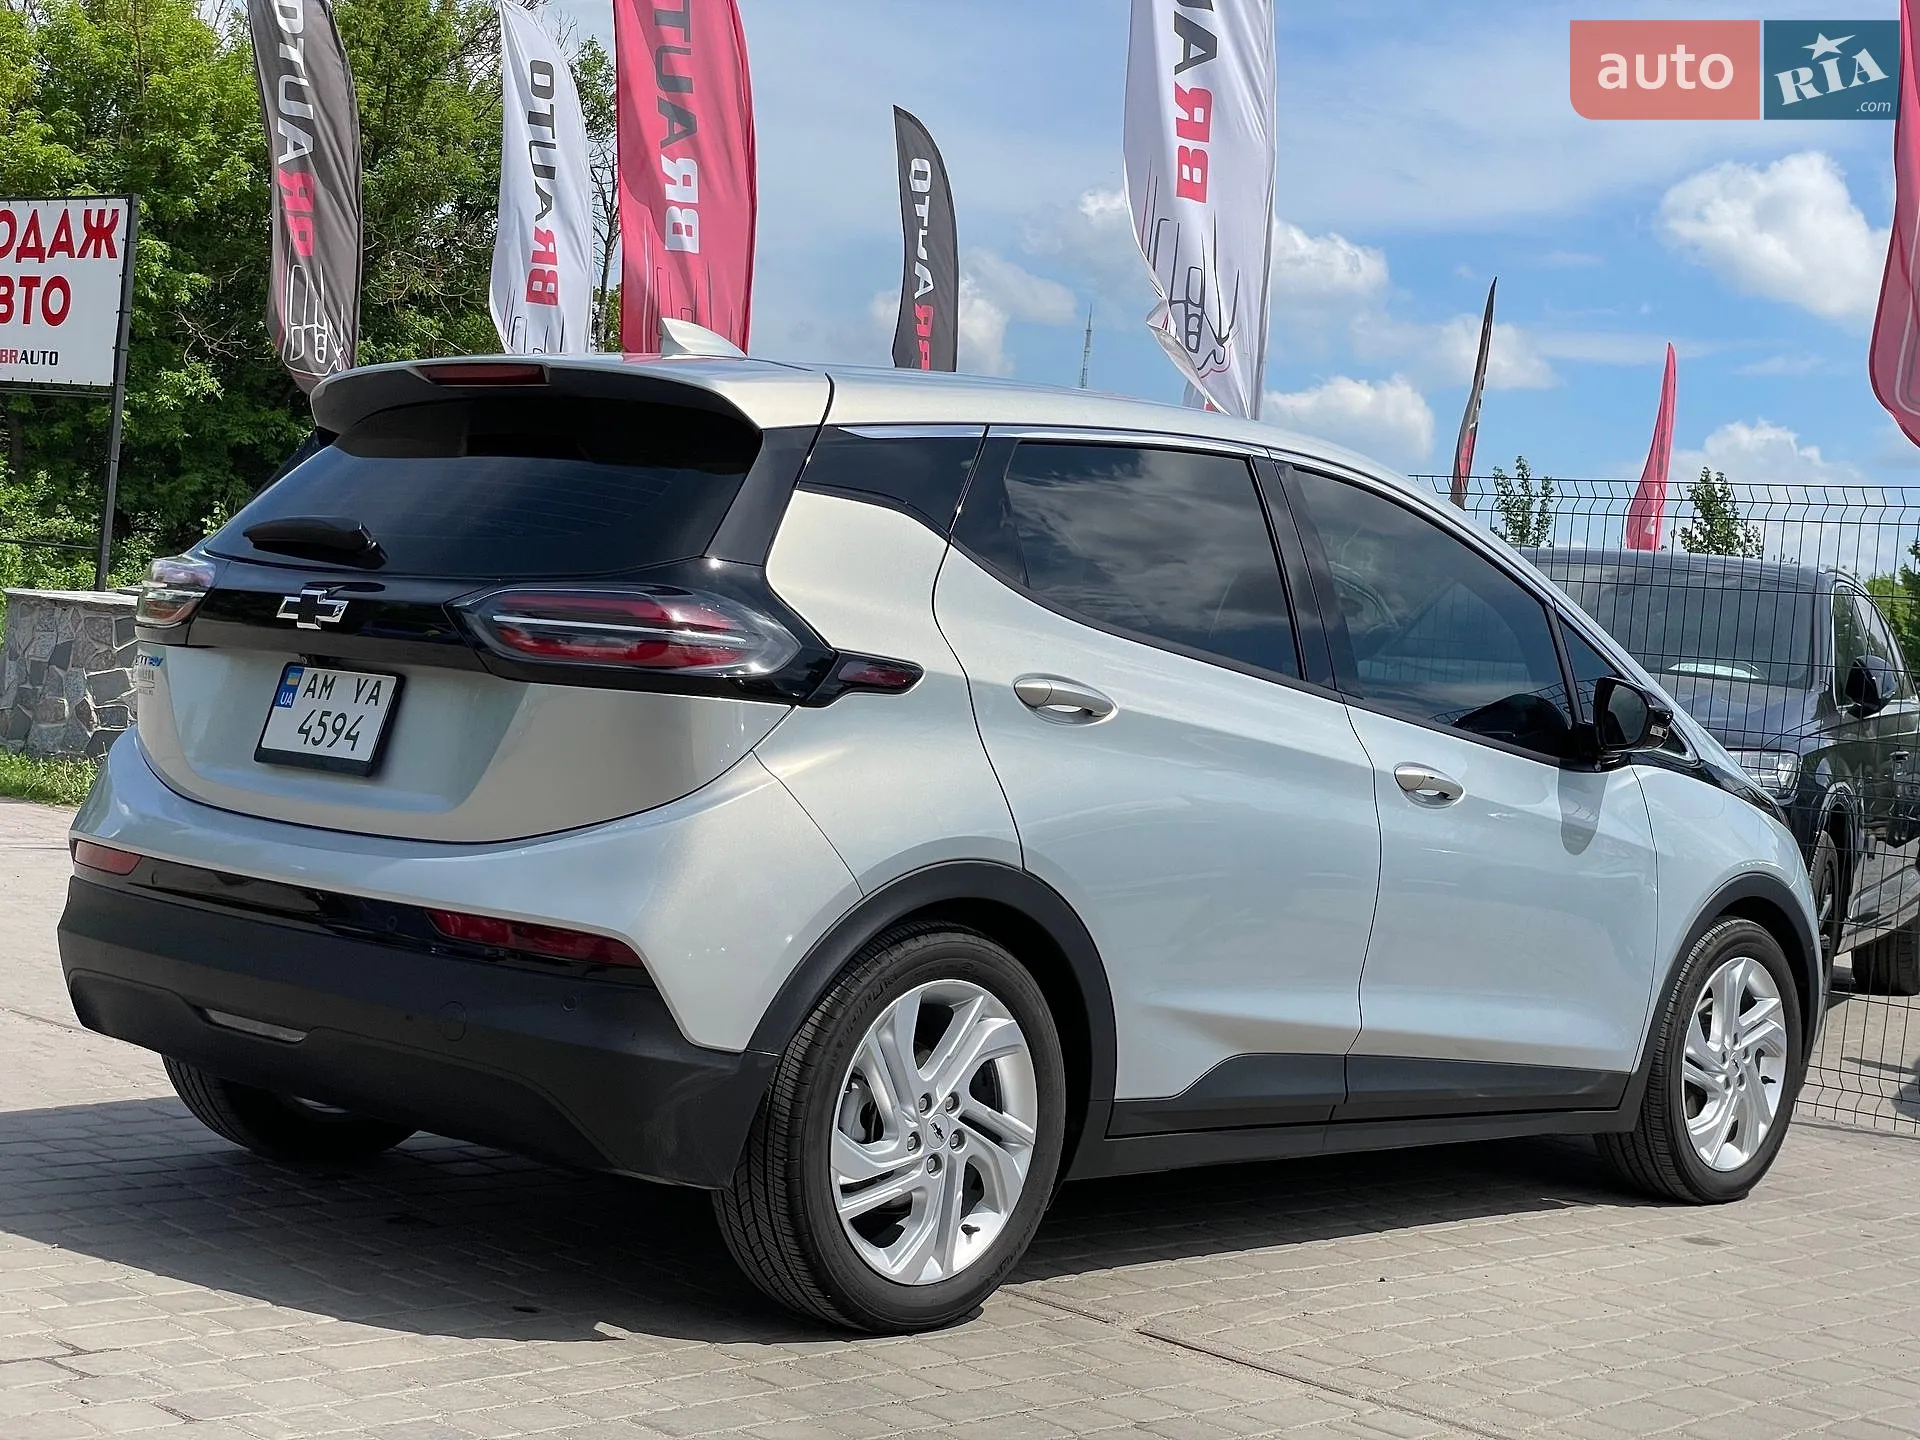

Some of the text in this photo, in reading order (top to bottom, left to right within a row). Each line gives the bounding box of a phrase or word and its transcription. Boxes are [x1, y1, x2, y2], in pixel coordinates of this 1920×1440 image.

[0, 349, 59, 366] BRAUTO
[280, 692, 295, 706] UA
[302, 673, 383, 707] AM YA
[297, 709, 365, 751] 4594
